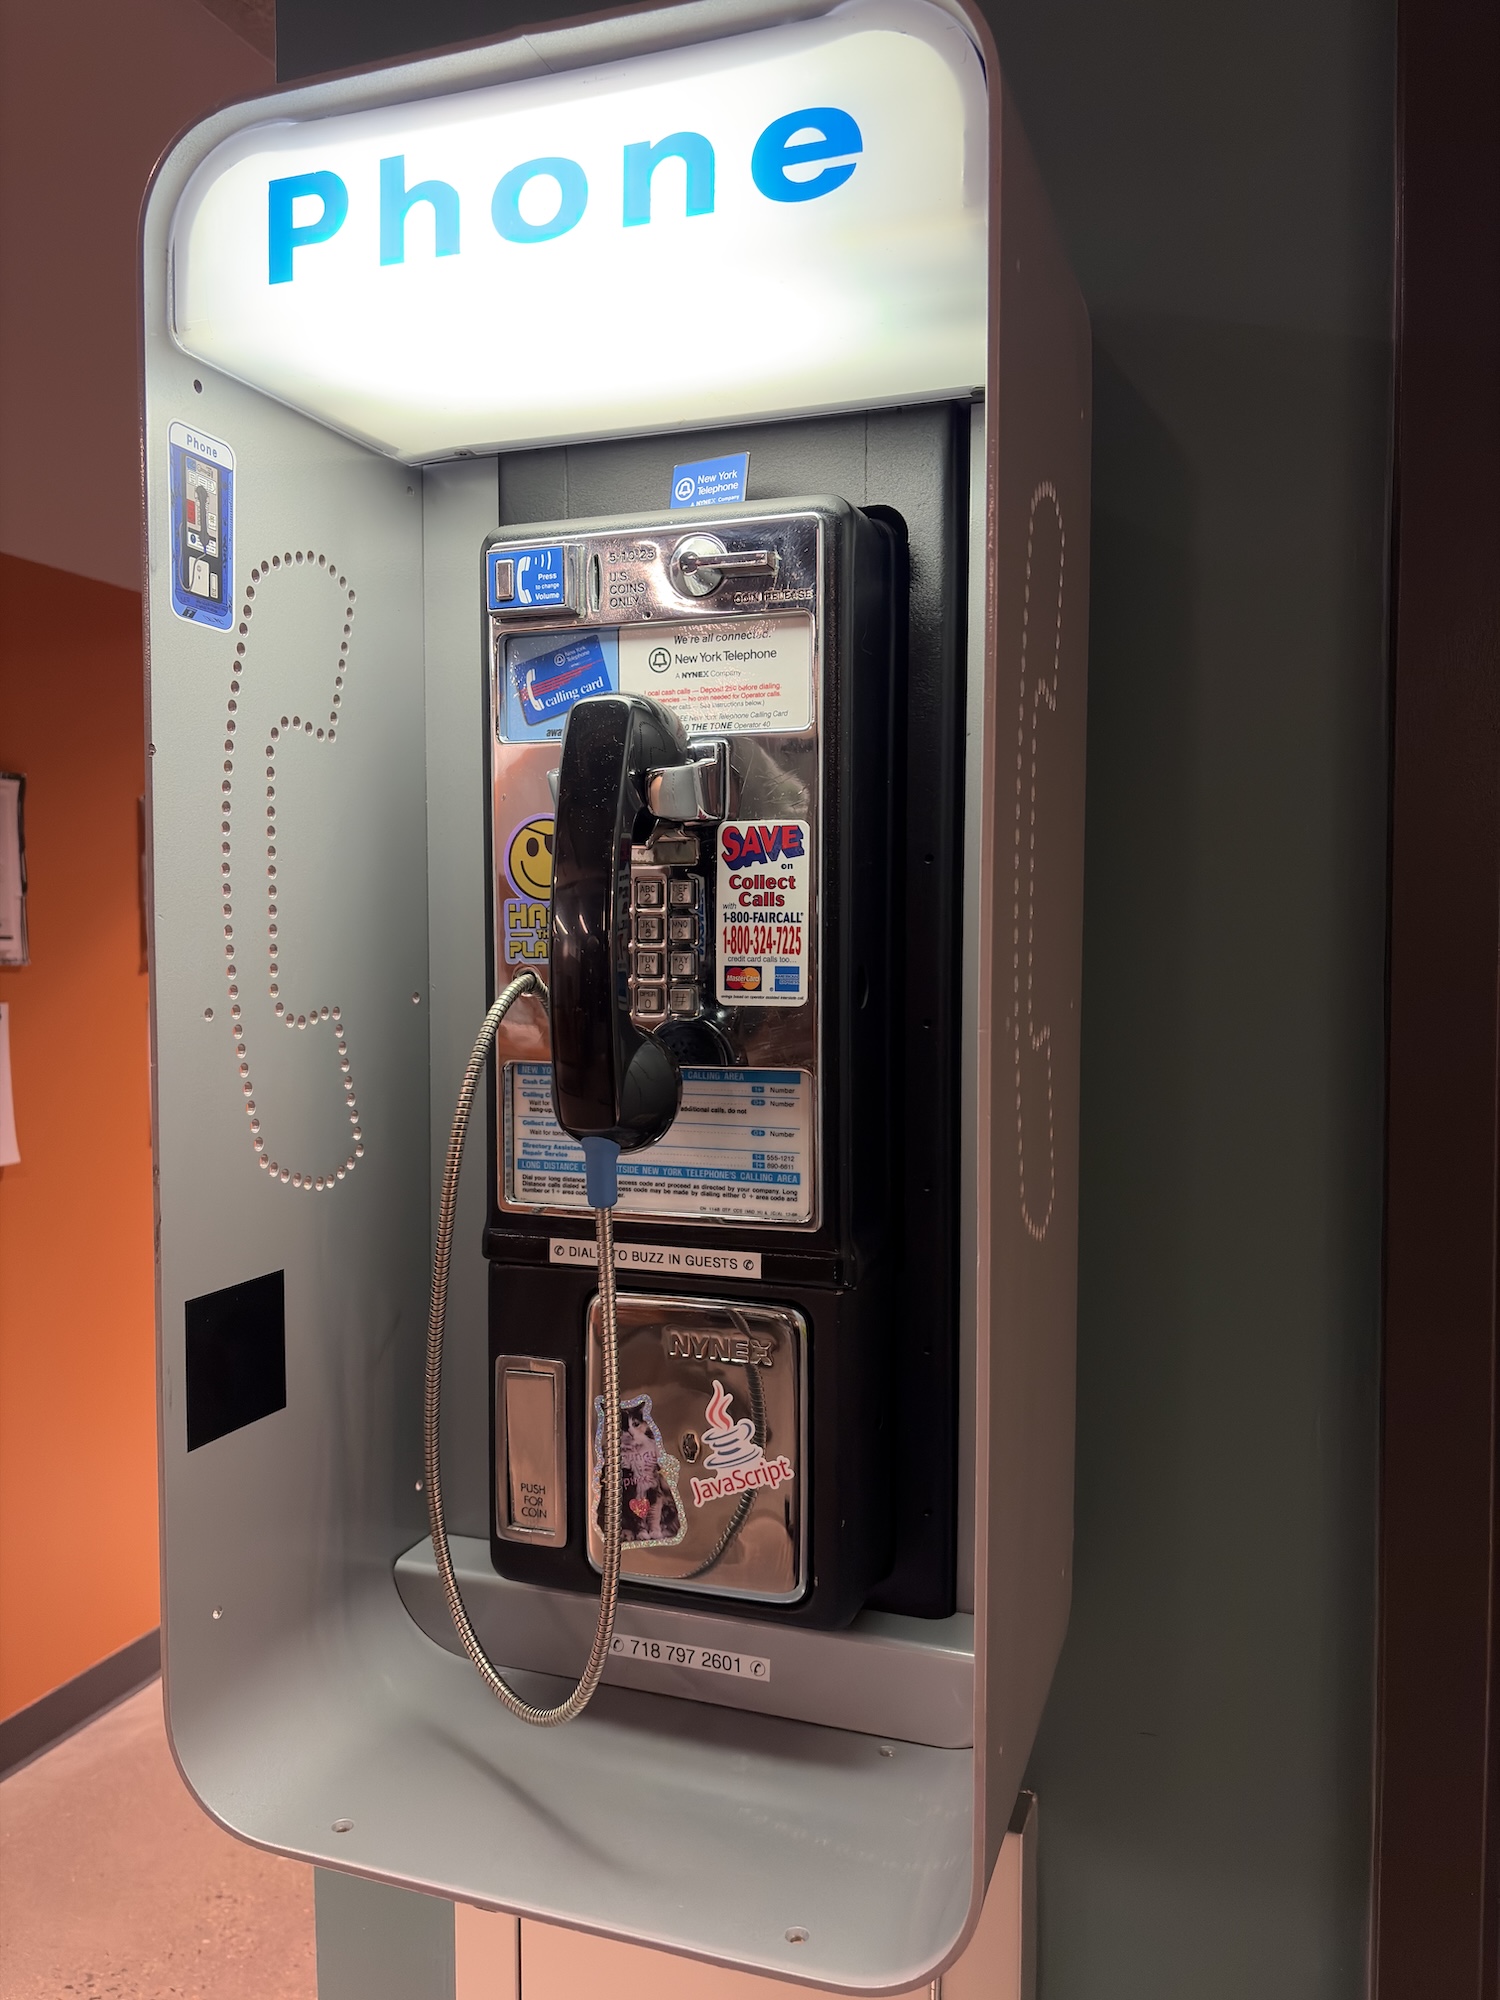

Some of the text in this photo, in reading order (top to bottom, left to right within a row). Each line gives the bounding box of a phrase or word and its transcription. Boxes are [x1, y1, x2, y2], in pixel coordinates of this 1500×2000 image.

[269, 107, 863, 285] Phone
[187, 434, 218, 459] Phone
[697, 469, 738, 485] New York
[697, 482, 739, 496] Telephone
[718, 495, 740, 503] Company
[537, 572, 557, 581] Press
[541, 582, 560, 590] change
[609, 582, 646, 595] COINS
[535, 592, 560, 601] Volume
[609, 596, 639, 609] ONLY
[734, 587, 814, 605] COIN RELEASE
[674, 635, 700, 645] We're
[702, 633, 714, 643] all
[675, 649, 777, 665] New York Telephone
[681, 671, 709, 679] NYNEX
[710, 670, 741, 678] Company
[545, 676, 604, 707] calling card
[661, 688, 676, 696] cash
[700, 686, 724, 694] Deposit
[691, 722, 708, 731] THE
[710, 721, 733, 730] TONE
[734, 721, 761, 729] Operator
[722, 825, 804, 871] SAVE
[672, 884, 688, 892] DEF
[729, 874, 796, 890] Collect
[640, 885, 655, 893] ABC
[678, 893, 684, 901] 3
[738, 891, 785, 907] Calls
[509, 903, 551, 928] HA
[640, 920, 655, 929] JKL
[723, 925, 801, 955] 1-800-324-7225
[640, 955, 655, 963] TUV
[645, 964, 651, 972] 8
[727, 975, 760, 983] MasterCard
[521, 1065, 538, 1074] NEW
[688, 1071, 720, 1080] CALLING
[724, 1072, 744, 1081] AREA
[522, 1091, 544, 1099] Calling
[522, 1142, 795, 1162] Directory 555-1212
[521, 1161, 540, 1169] LONG
[543, 1162, 579, 1170] DISTANCE
[642, 1166, 659, 1175] NEW
[662, 1168, 682, 1176] YORK
[686, 1169, 736, 1180] TELEPHONE'S
[740, 1172, 773, 1182] CALLING
[777, 1174, 798, 1183] AREA
[766, 1162, 794, 1170] 890-6611
[667, 1182, 691, 1190] proceed
[701, 1183, 726, 1191] directed
[700, 1190, 720, 1198] dialing
[568, 1246, 596, 1259] DIAL
[631, 1251, 664, 1264] BUZZ
[668, 1253, 681, 1266] IN
[685, 1255, 738, 1270] GUESTS
[669, 1332, 773, 1366] NYNEX
[520, 1482, 546, 1495] PUSH
[693, 1459, 791, 1505] JavaScript
[524, 1495, 543, 1507] FOR
[521, 1506, 547, 1519] COIN
[630, 1639, 741, 1673] 718 797 2601
